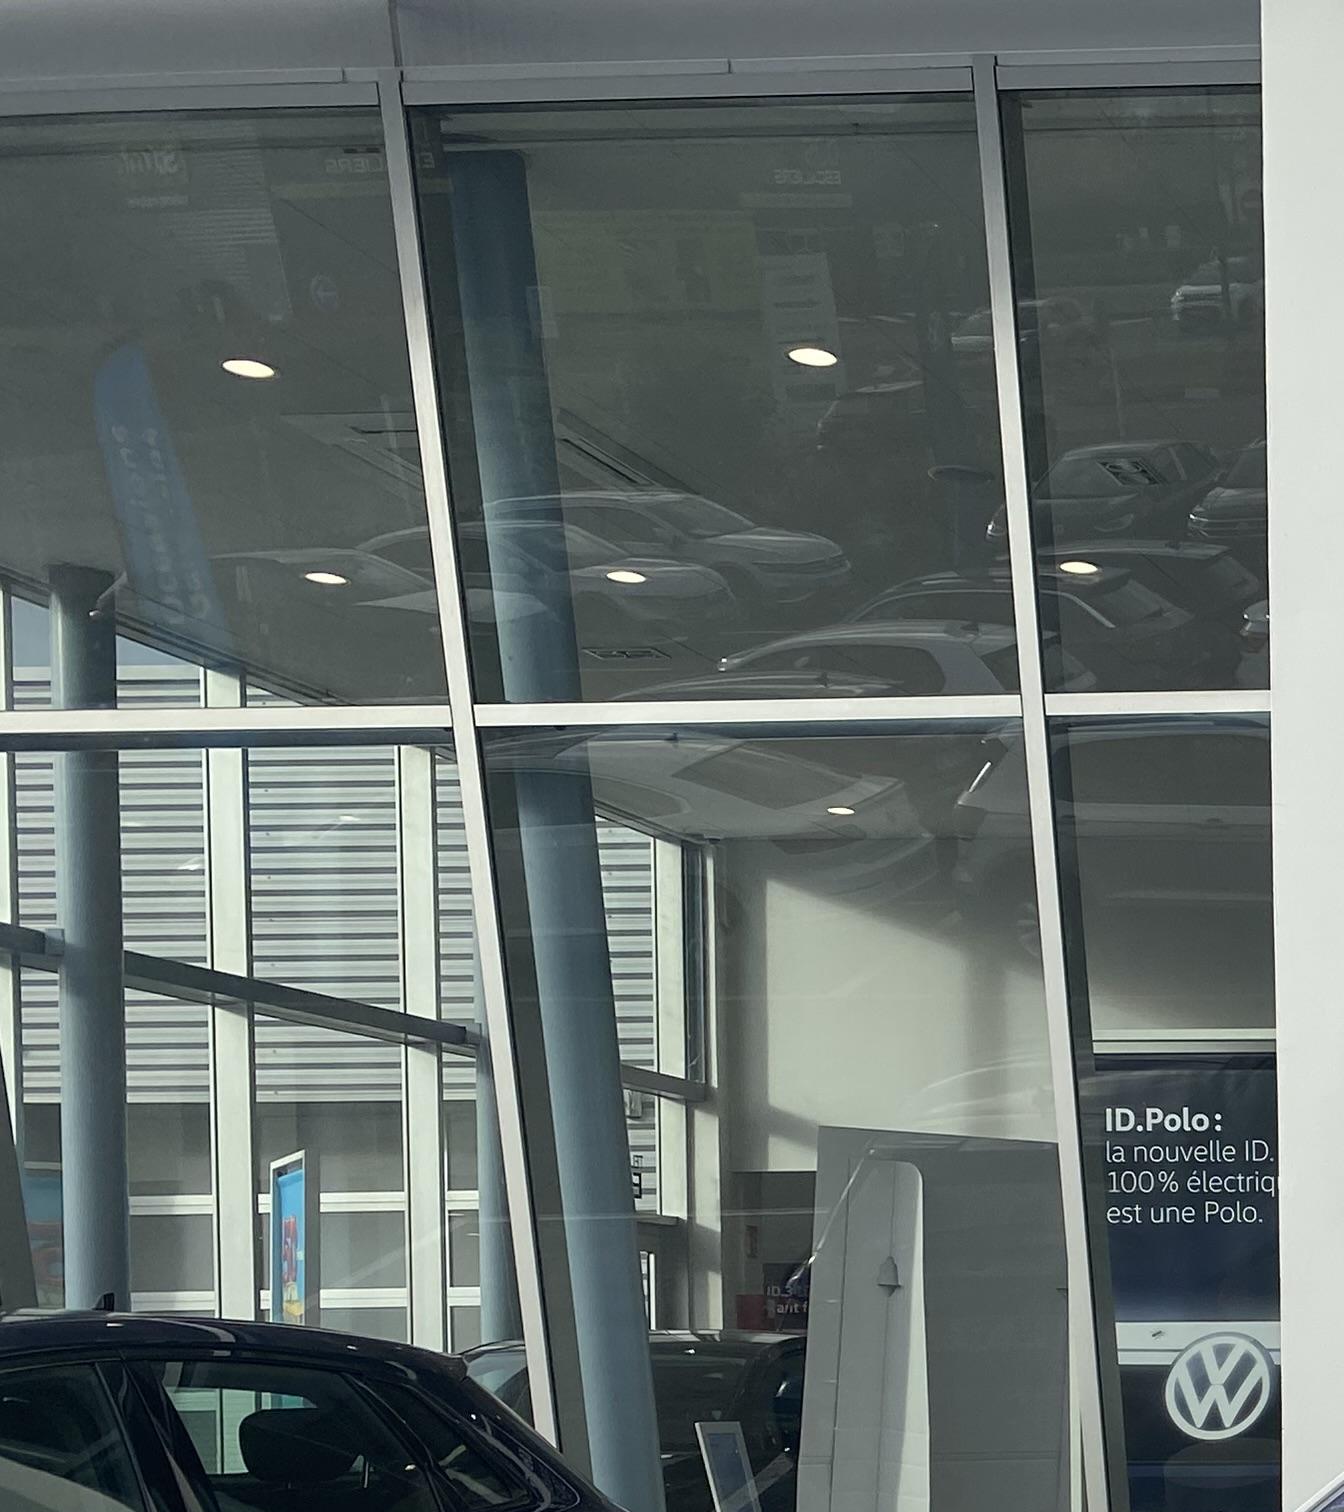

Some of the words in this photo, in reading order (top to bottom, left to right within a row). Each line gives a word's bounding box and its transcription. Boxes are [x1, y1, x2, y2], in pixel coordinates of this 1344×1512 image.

[1106, 1140, 1125, 1163] la
[1134, 1140, 1236, 1163] nouvelle
[1245, 1140, 1275, 1162] ID.
[1108, 1170, 1179, 1193] 100%
[1186, 1170, 1279, 1198] électriq
[1106, 1203, 1142, 1223] est
[1150, 1205, 1196, 1223] une
[1205, 1201, 1263, 1223] Polo.
